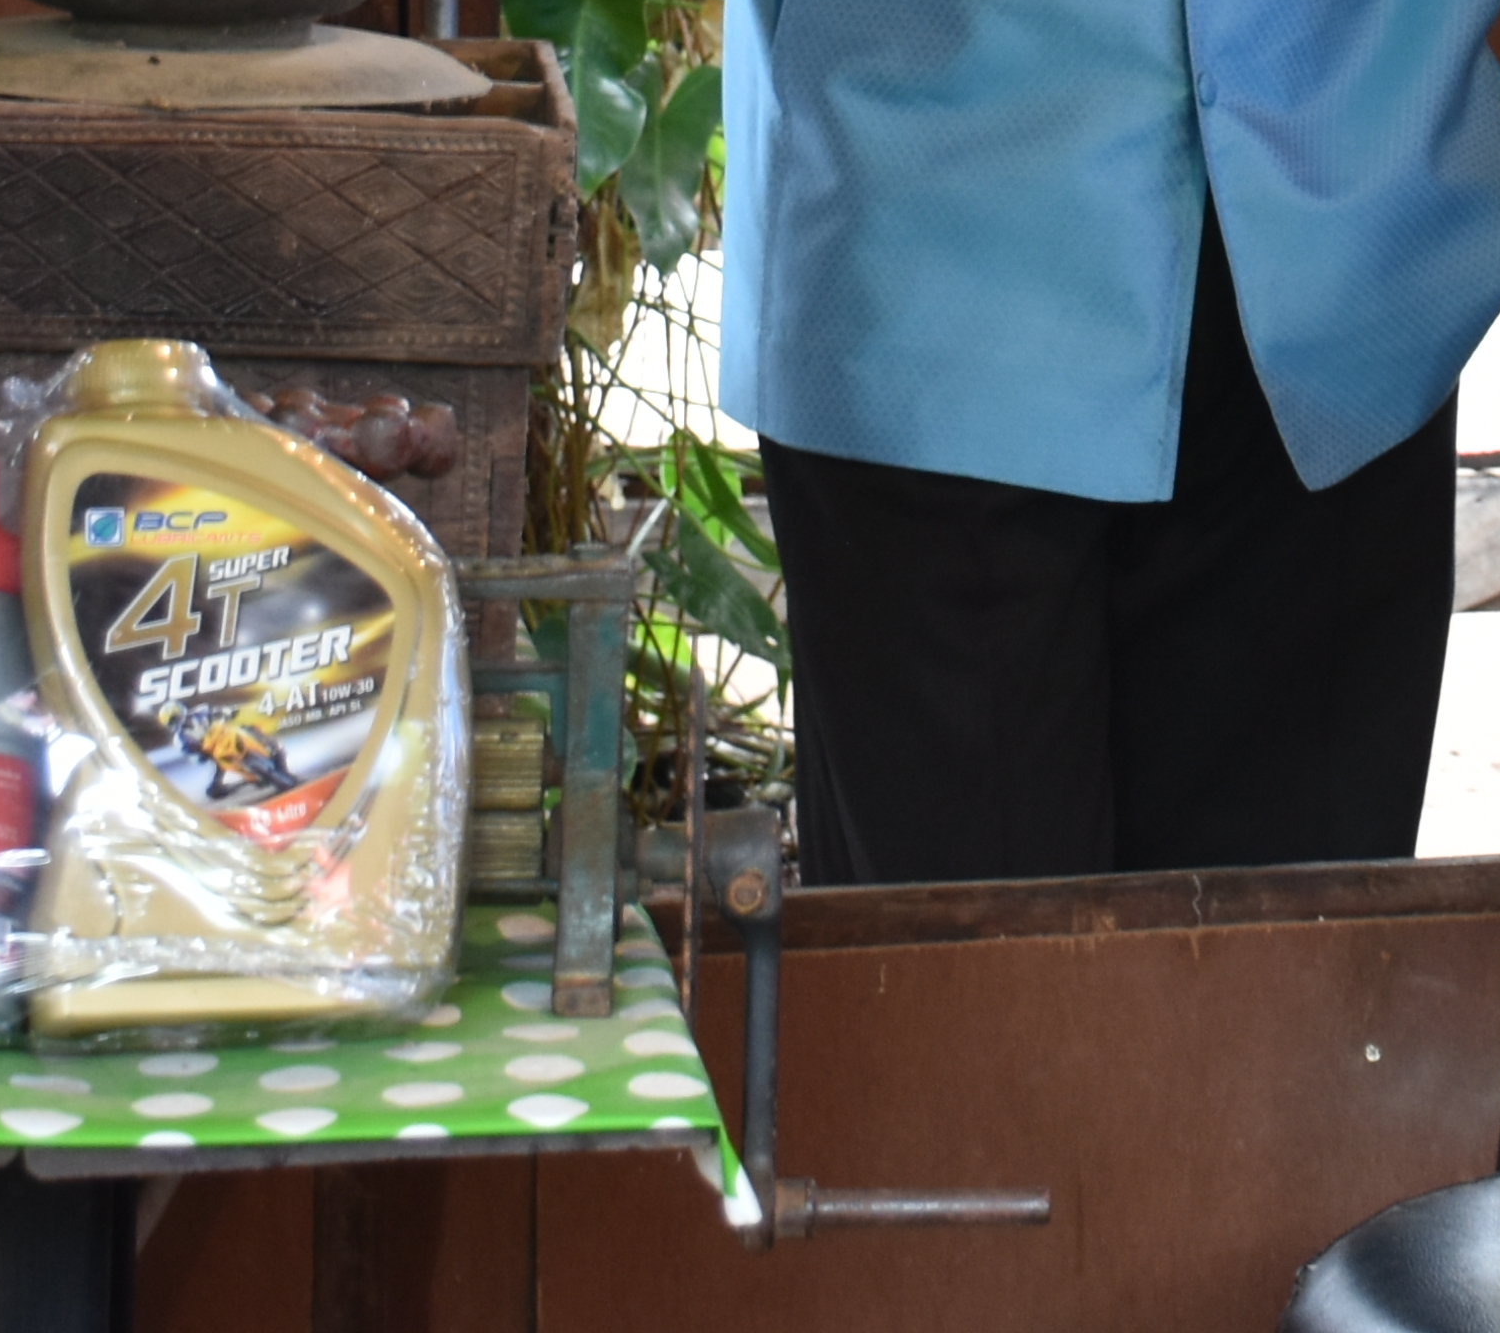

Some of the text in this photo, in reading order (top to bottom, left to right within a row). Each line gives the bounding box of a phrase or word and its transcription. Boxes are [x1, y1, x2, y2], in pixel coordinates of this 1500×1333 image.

[133, 510, 229, 532] BCP
[129, 531, 262, 546] LUBRICANTS
[207, 544, 293, 583] SUPER
[134, 624, 354, 713] SCOOTER
[321, 676, 375, 704] 10W-30
